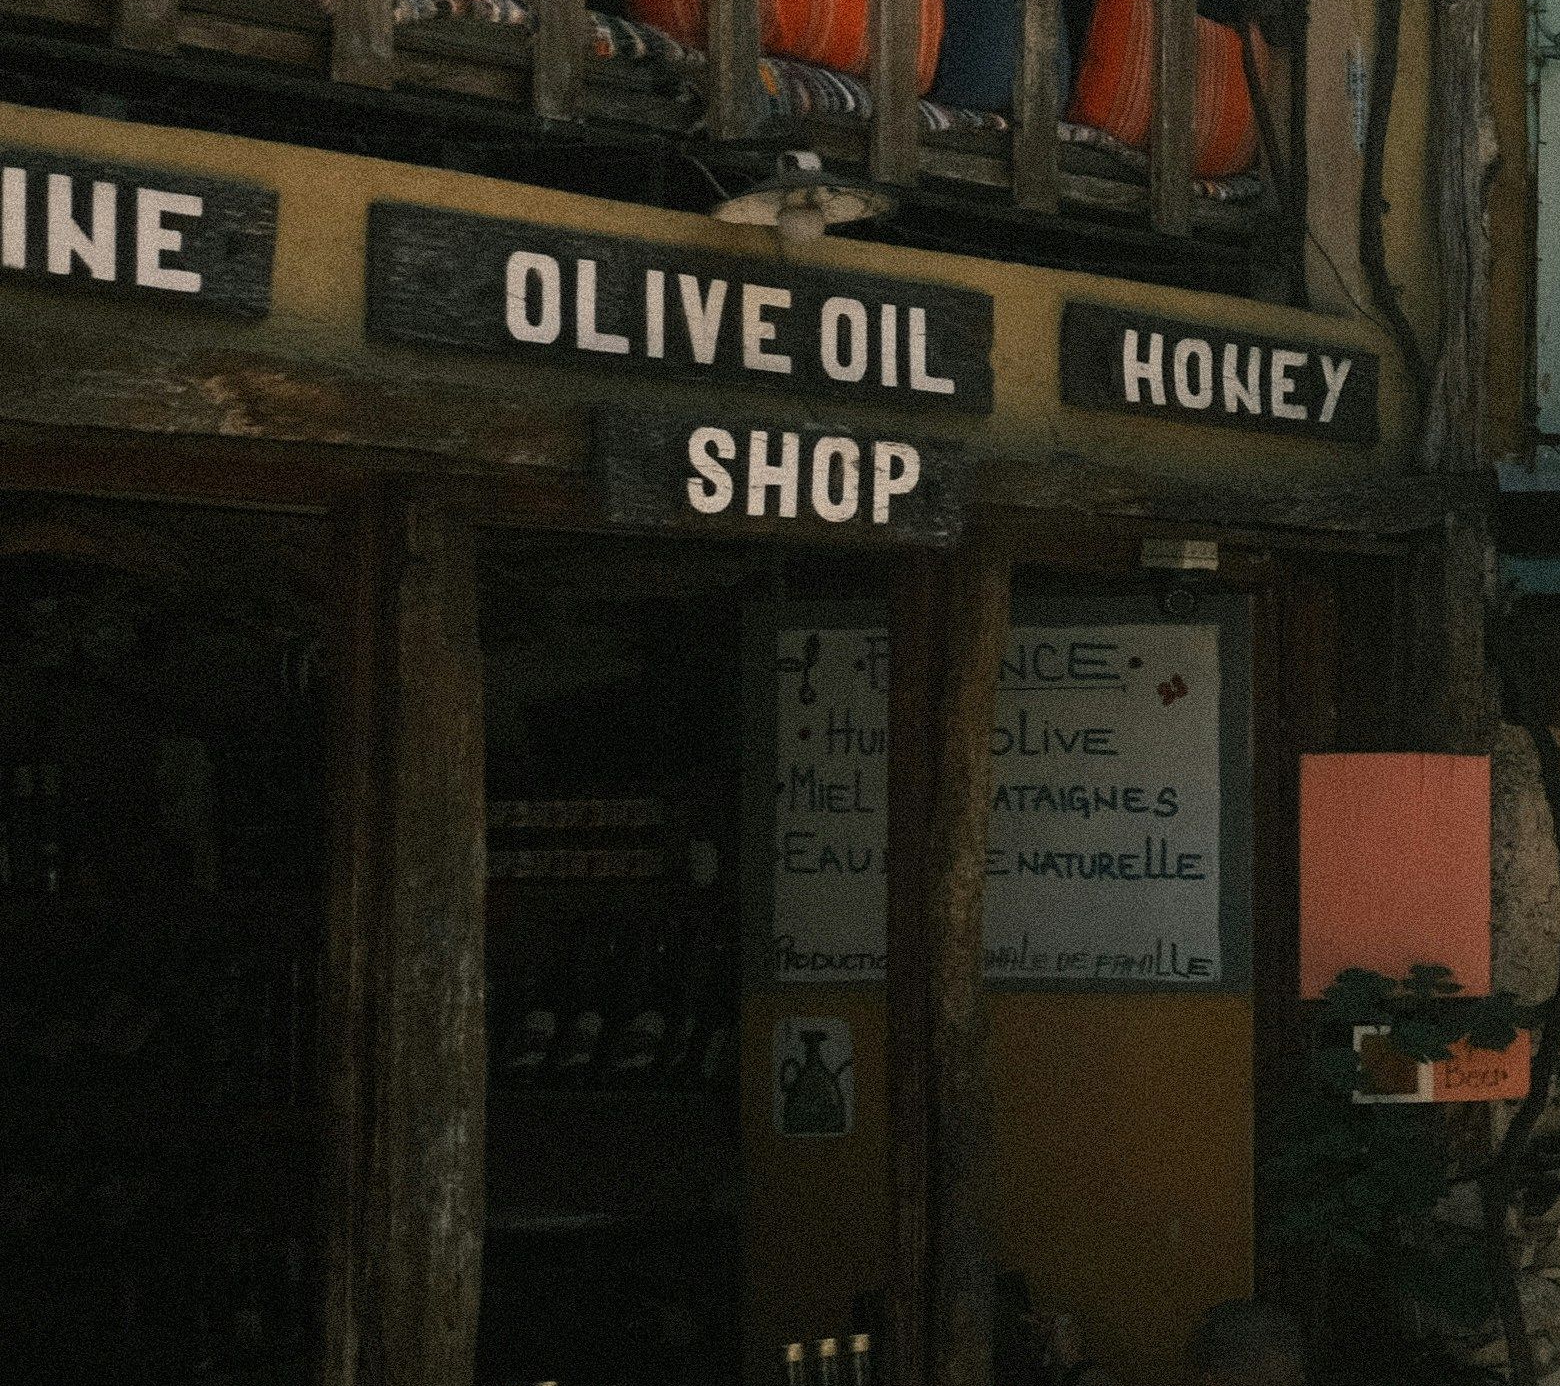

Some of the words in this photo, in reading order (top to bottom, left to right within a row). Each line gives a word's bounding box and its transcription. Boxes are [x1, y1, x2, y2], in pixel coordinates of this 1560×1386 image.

[504, 249, 793, 376] OLIVE
[819, 295, 957, 395] OIL
[1122, 328, 1353, 424] HONEY
[685, 425, 921, 525] SHOP
